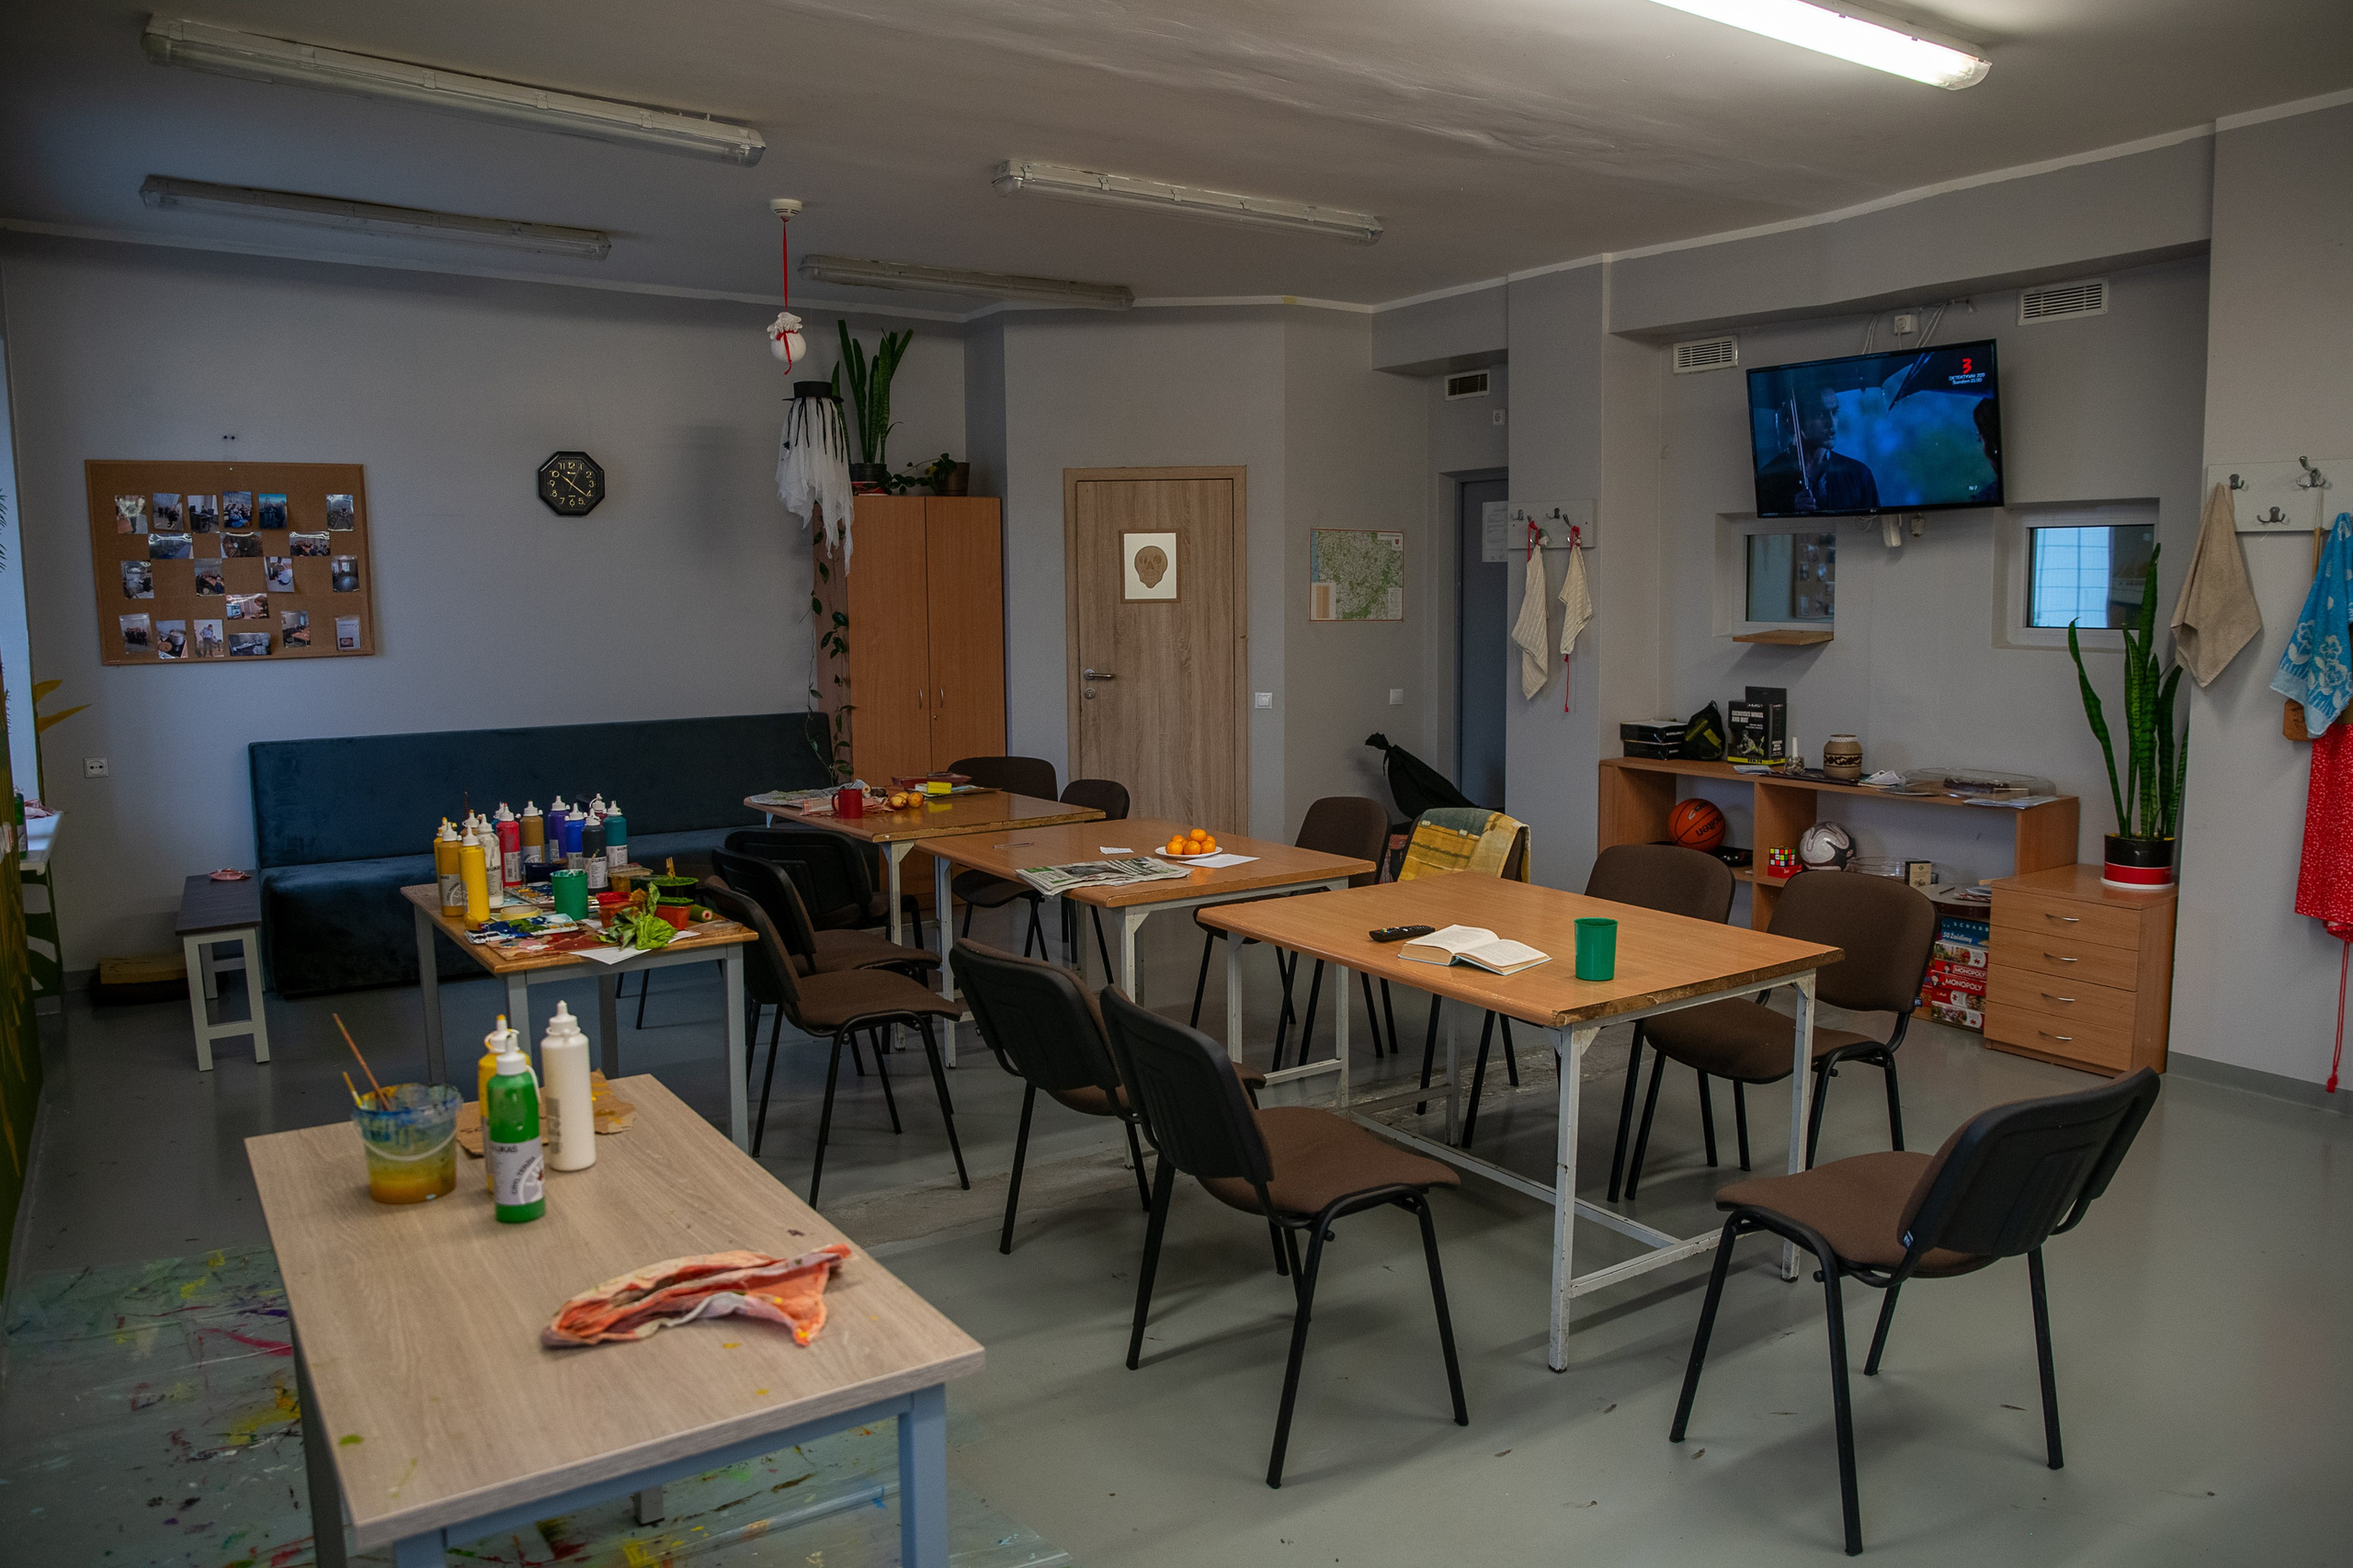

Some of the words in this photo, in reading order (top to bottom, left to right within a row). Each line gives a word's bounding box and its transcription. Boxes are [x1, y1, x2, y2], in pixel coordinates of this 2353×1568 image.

[1962, 358, 1972, 374] 3
[558, 461, 565, 470] 11
[568, 461, 575, 470] 12
[551, 470, 560, 478] 10
[585, 471, 592, 479] 2
[588, 480, 595, 488] 3
[551, 489, 558, 497] 8
[560, 496, 565, 505] 7
[569, 498, 575, 506] 6
[578, 497, 585, 506] 5
[1695, 813, 1723, 836] molten
[1954, 967, 1985, 978] MONOPOLY
[1945, 977, 1983, 991] MONOPOLY
